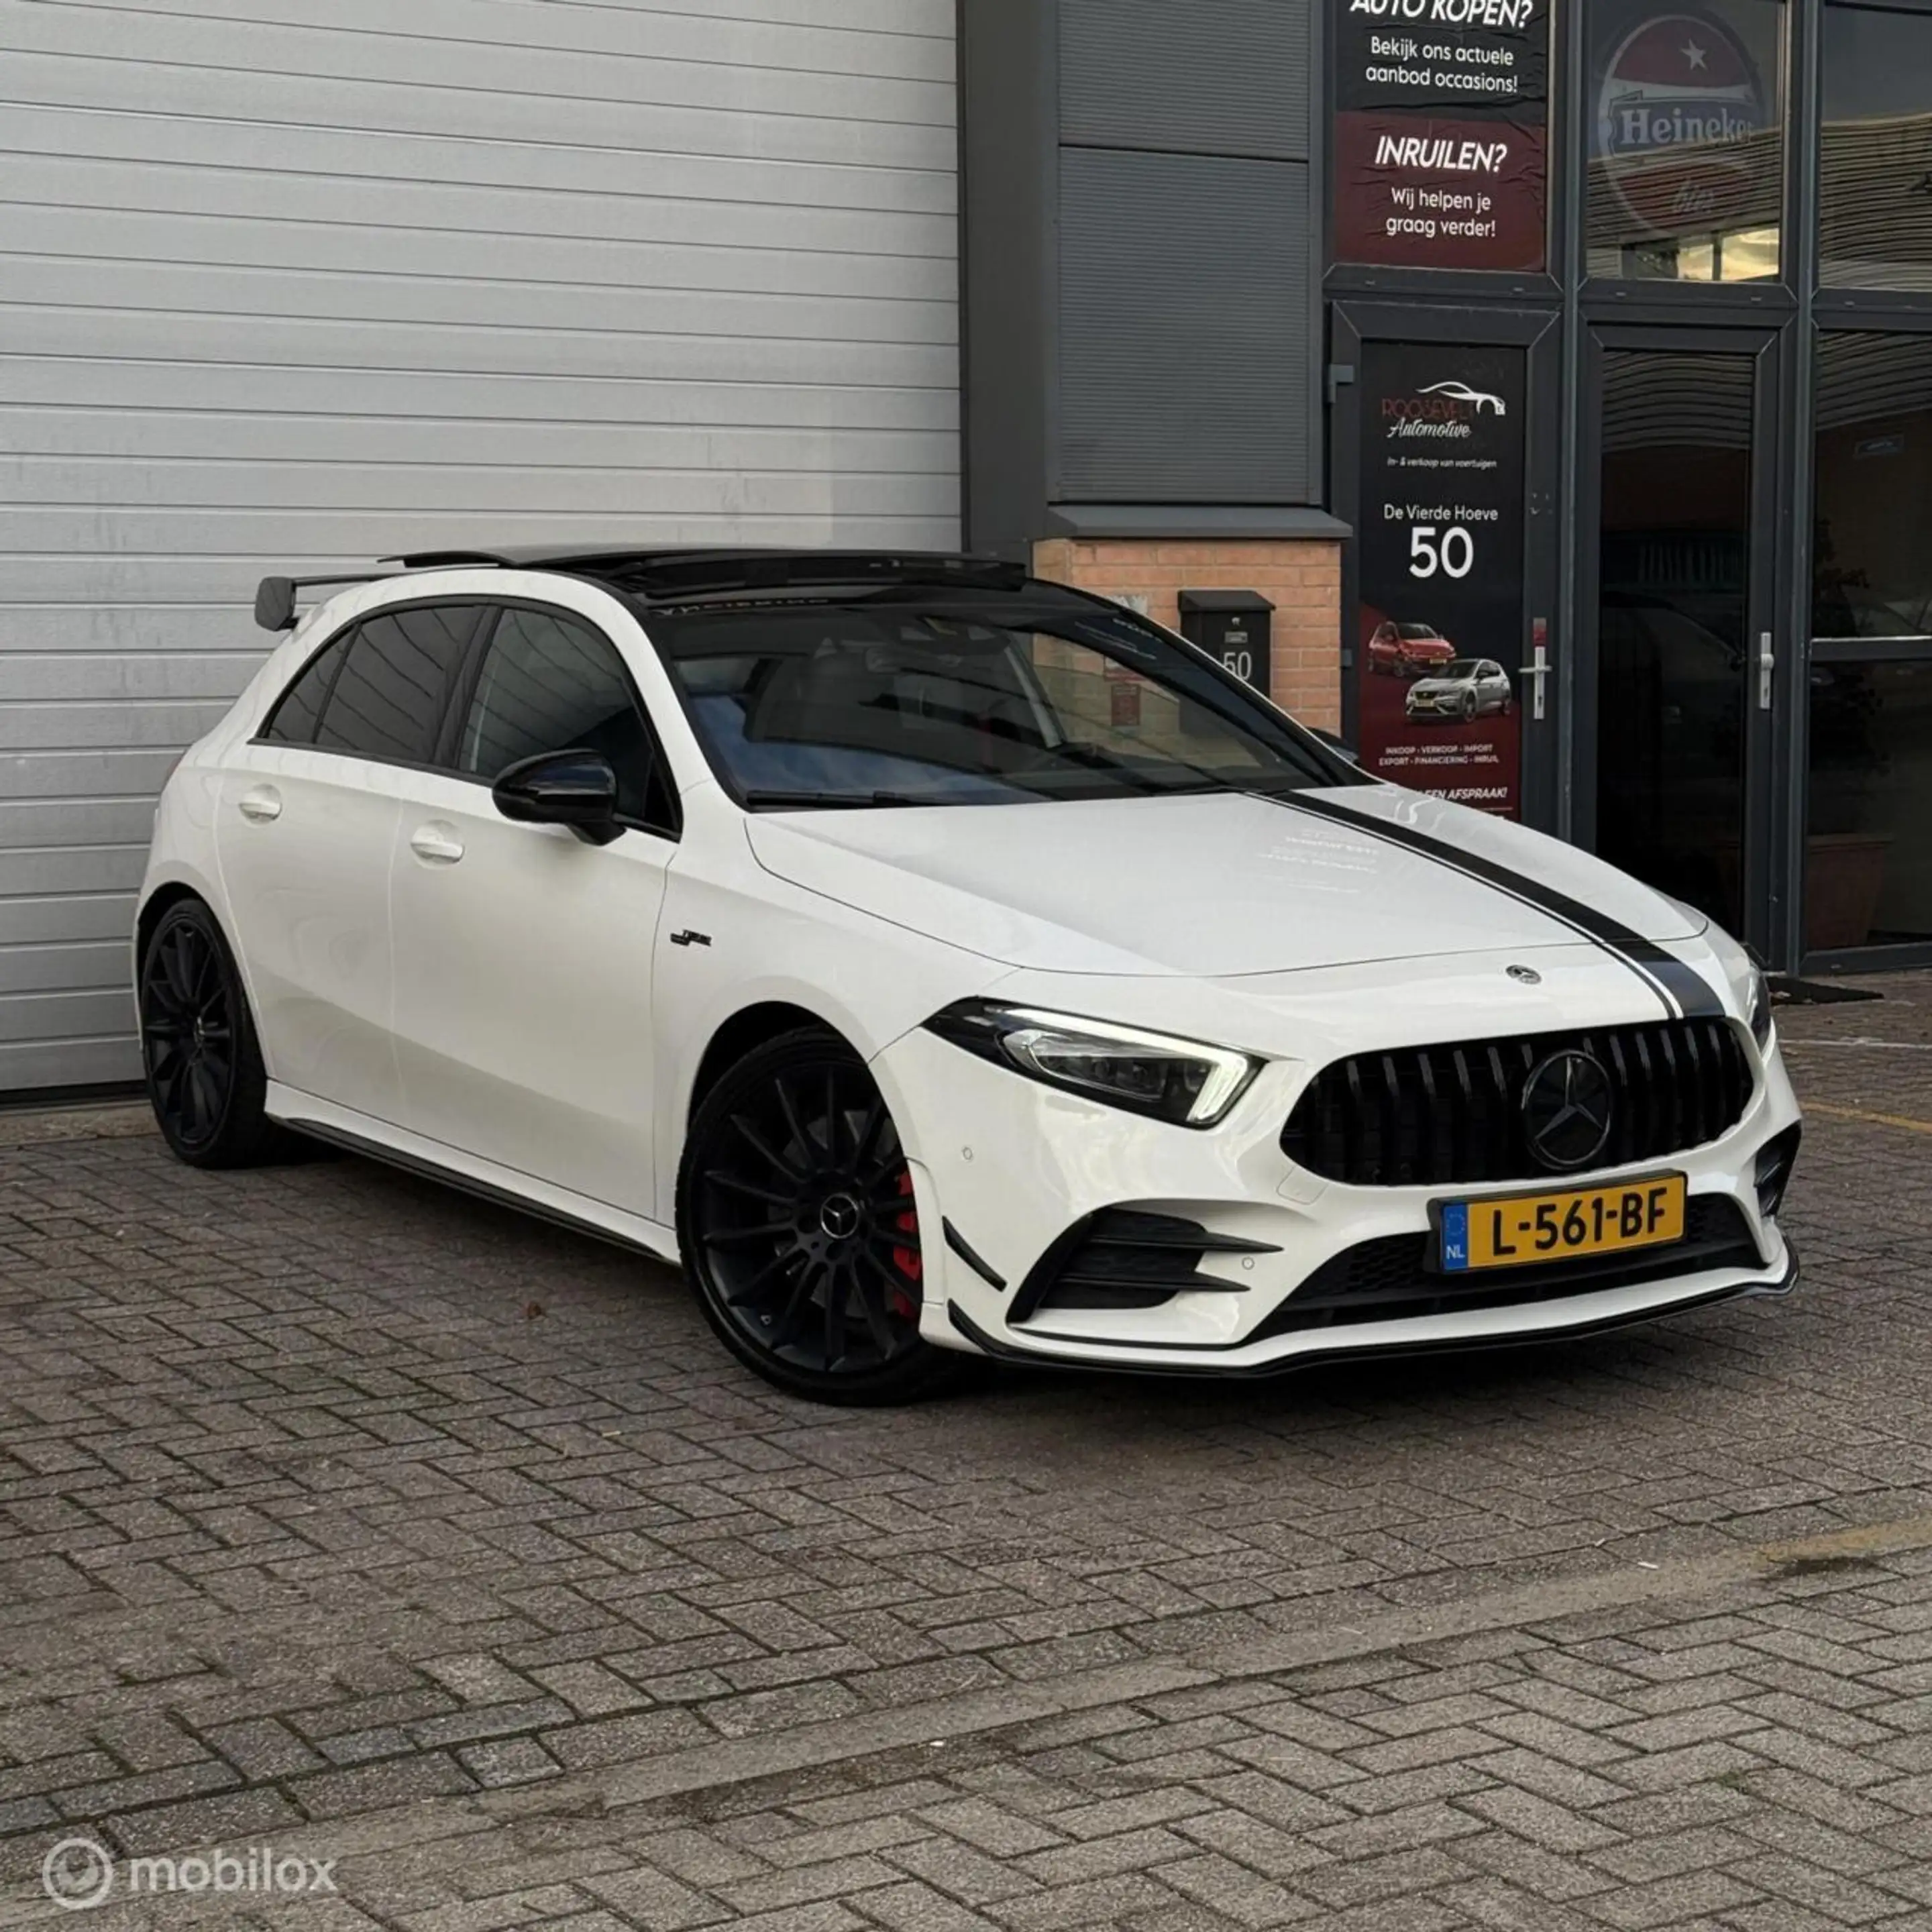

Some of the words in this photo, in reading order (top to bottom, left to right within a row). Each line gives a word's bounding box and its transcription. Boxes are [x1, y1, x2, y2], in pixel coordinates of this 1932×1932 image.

[1431, 0, 1533, 28] KOPEN?
[1371, 36, 1418, 61] Bekijk
[1422, 44, 1452, 60] ons
[1455, 48, 1514, 66] actuele
[1366, 66, 1431, 86] aanbod
[1435, 73, 1518, 93] occasions!
[1375, 136, 1507, 172] INRUILEN?
[1391, 187, 1414, 210] Wij
[1419, 189, 1472, 211] helpen
[1476, 193, 1491, 213] je
[1386, 218, 1436, 238] graag
[1440, 220, 1496, 237] verder!
[1387, 417, 1472, 438] Automotive
[1399, 456, 1406, 466] &
[1407, 458, 1439, 469] verkoop
[1455, 460, 1497, 470] voertuigen
[1384, 504, 1403, 519] De
[1407, 505, 1452, 520] Vierde
[1454, 506, 1499, 521] Hoeve
[1409, 527, 1474, 578] 50
[1224, 651, 1252, 681] 50
[1385, 747, 1415, 755] INKOOP
[1421, 745, 1458, 753] VERKOOP
[1464, 744, 1493, 752] IMPORT
[1379, 757, 1409, 766] EXPORT
[1414, 757, 1468, 765] FINANCIERING
[1447, 787, 1508, 799] AFSPRAAK!
[1493, 1187, 1668, 1256] L-561-BF
[1446, 1246, 1465, 1259] NL
